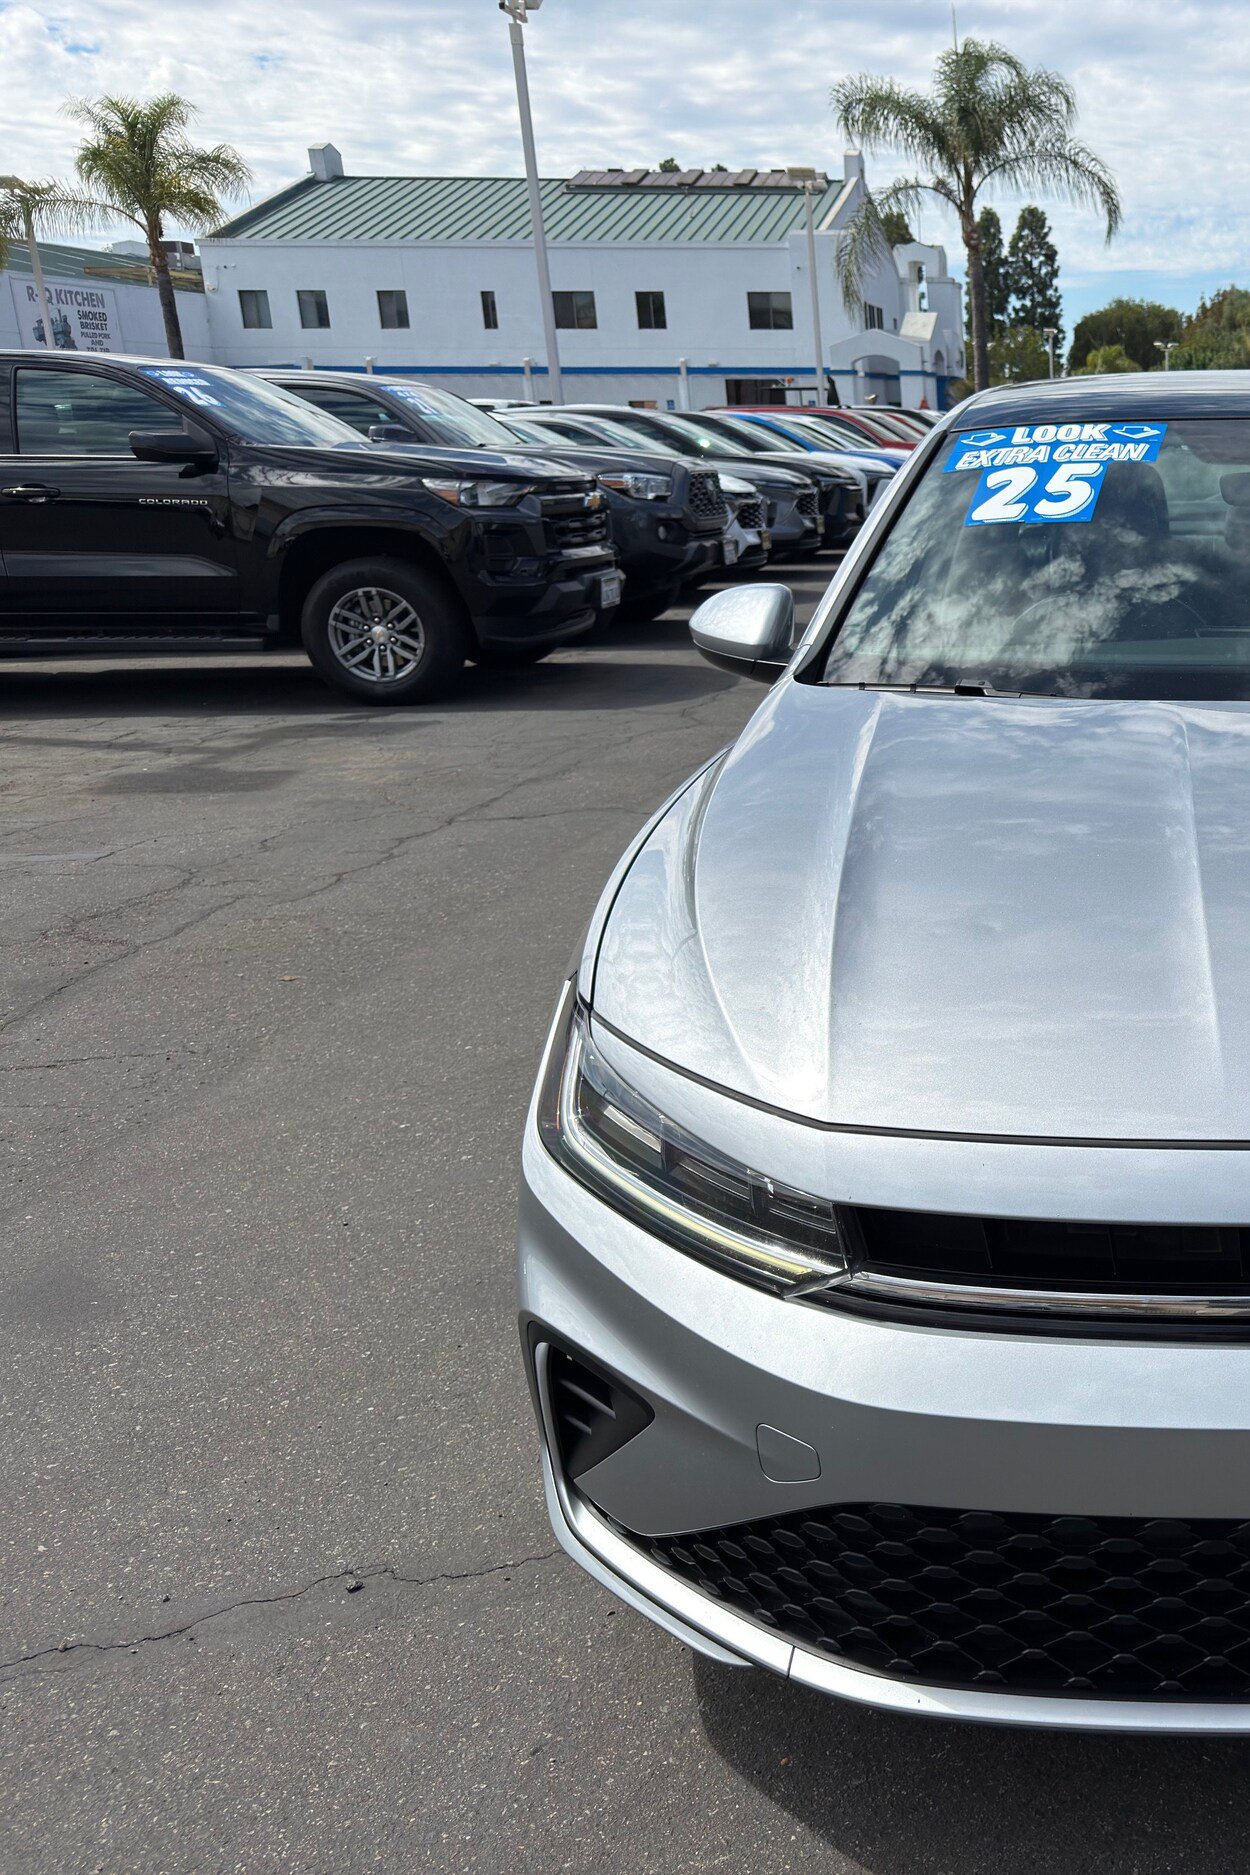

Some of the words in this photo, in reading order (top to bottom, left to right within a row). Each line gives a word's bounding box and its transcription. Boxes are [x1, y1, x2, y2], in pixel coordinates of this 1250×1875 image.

[54, 288, 106, 309] KITCHEN
[77, 309, 107, 322] SMOKED
[80, 321, 108, 331] BRISKET
[1011, 423, 1113, 444] LOOK
[955, 445, 1051, 471] EXTRA
[1052, 443, 1150, 461] CLEAN
[138, 498, 208, 506] COLORADO
[971, 463, 1103, 523] 25
